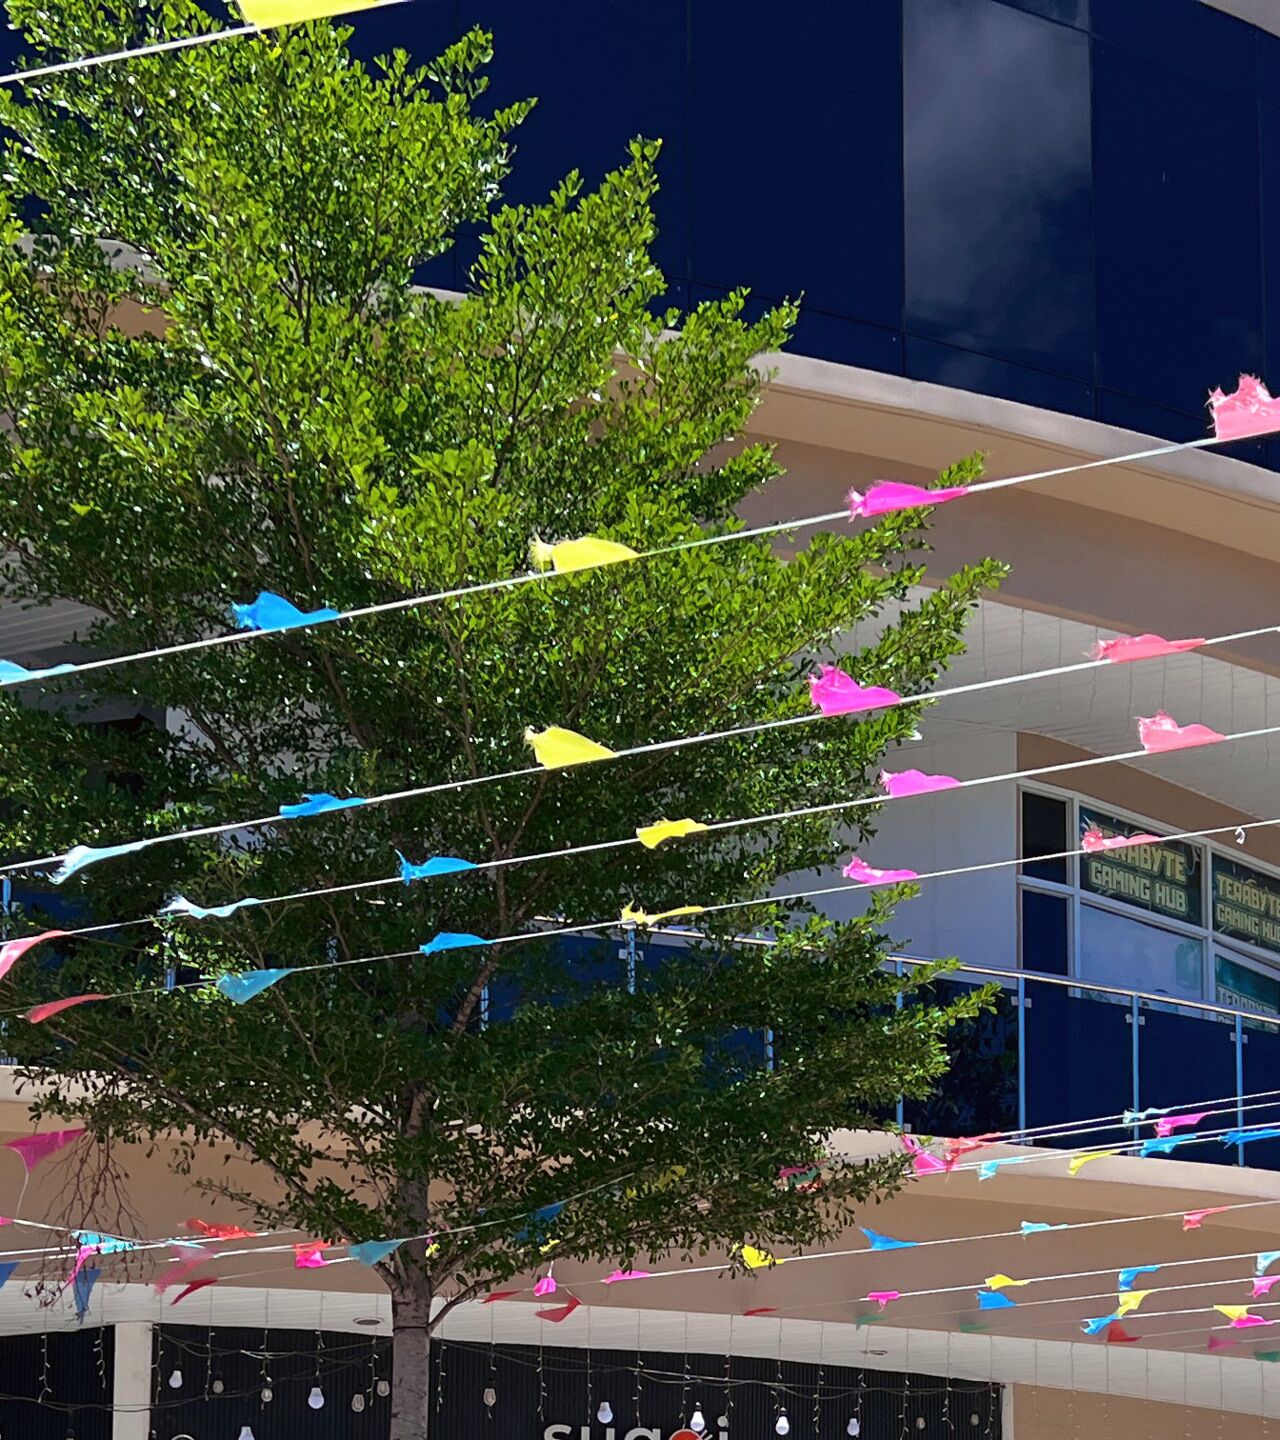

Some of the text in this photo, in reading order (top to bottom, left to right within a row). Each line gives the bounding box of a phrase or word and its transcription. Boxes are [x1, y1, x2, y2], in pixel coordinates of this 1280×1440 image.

[1090, 861, 1186, 912] GAMING HUB
[1216, 903, 1259, 936] GAMING
